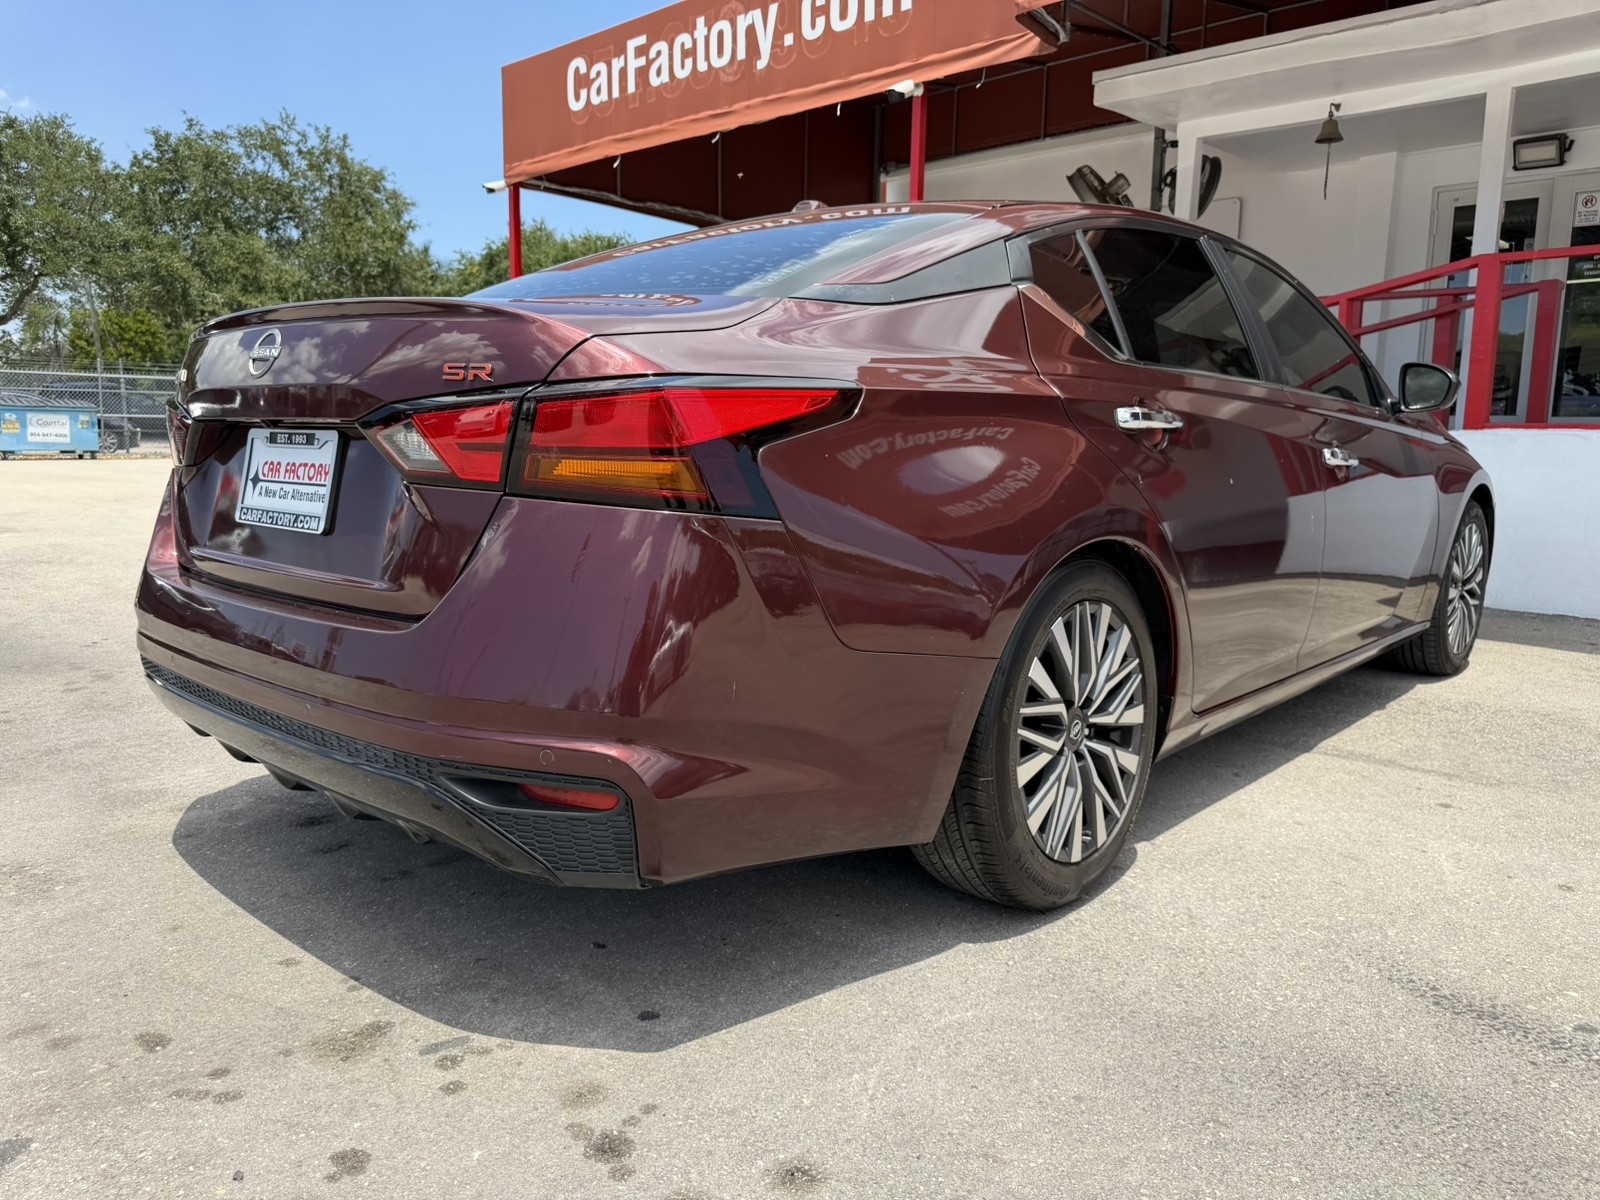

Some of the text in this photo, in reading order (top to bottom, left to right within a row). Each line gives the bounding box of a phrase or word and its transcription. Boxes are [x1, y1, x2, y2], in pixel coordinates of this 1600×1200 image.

[252, 348, 279, 357] SSAN
[442, 363, 494, 382] SR
[277, 434, 307, 444] EST. 1993
[262, 461, 331, 482] CAR FACTORY
[258, 486, 326, 503] A New Car Alternative
[240, 508, 320, 530] CARFACTORY.COM
